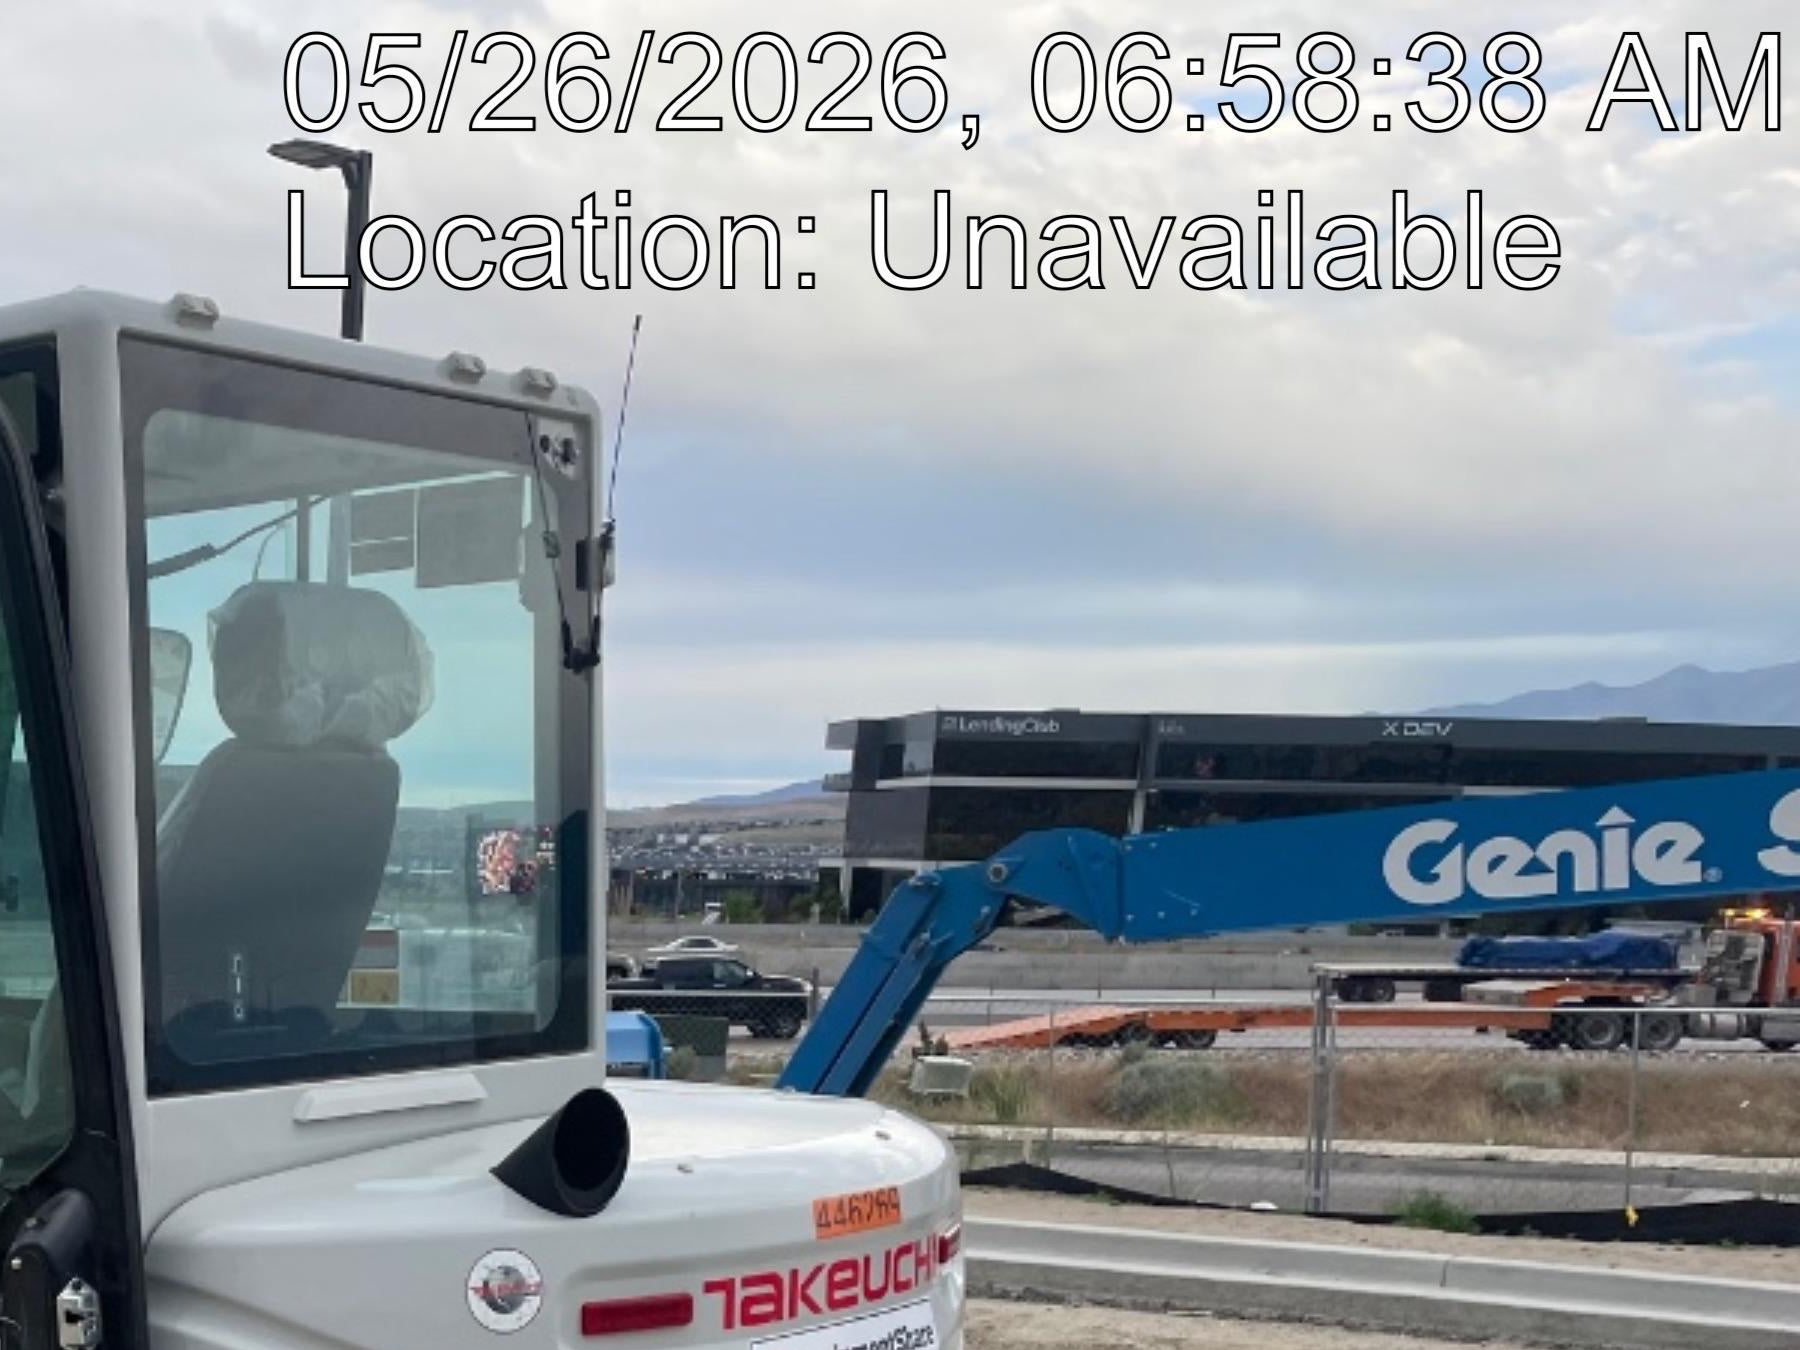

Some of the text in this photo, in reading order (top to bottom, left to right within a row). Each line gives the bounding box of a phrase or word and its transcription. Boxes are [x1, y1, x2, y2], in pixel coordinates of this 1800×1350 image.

[959, 716, 1060, 737] LendingClub
[1382, 804, 1705, 905] Genie
[704, 1233, 938, 1330] TAKEUCHI
